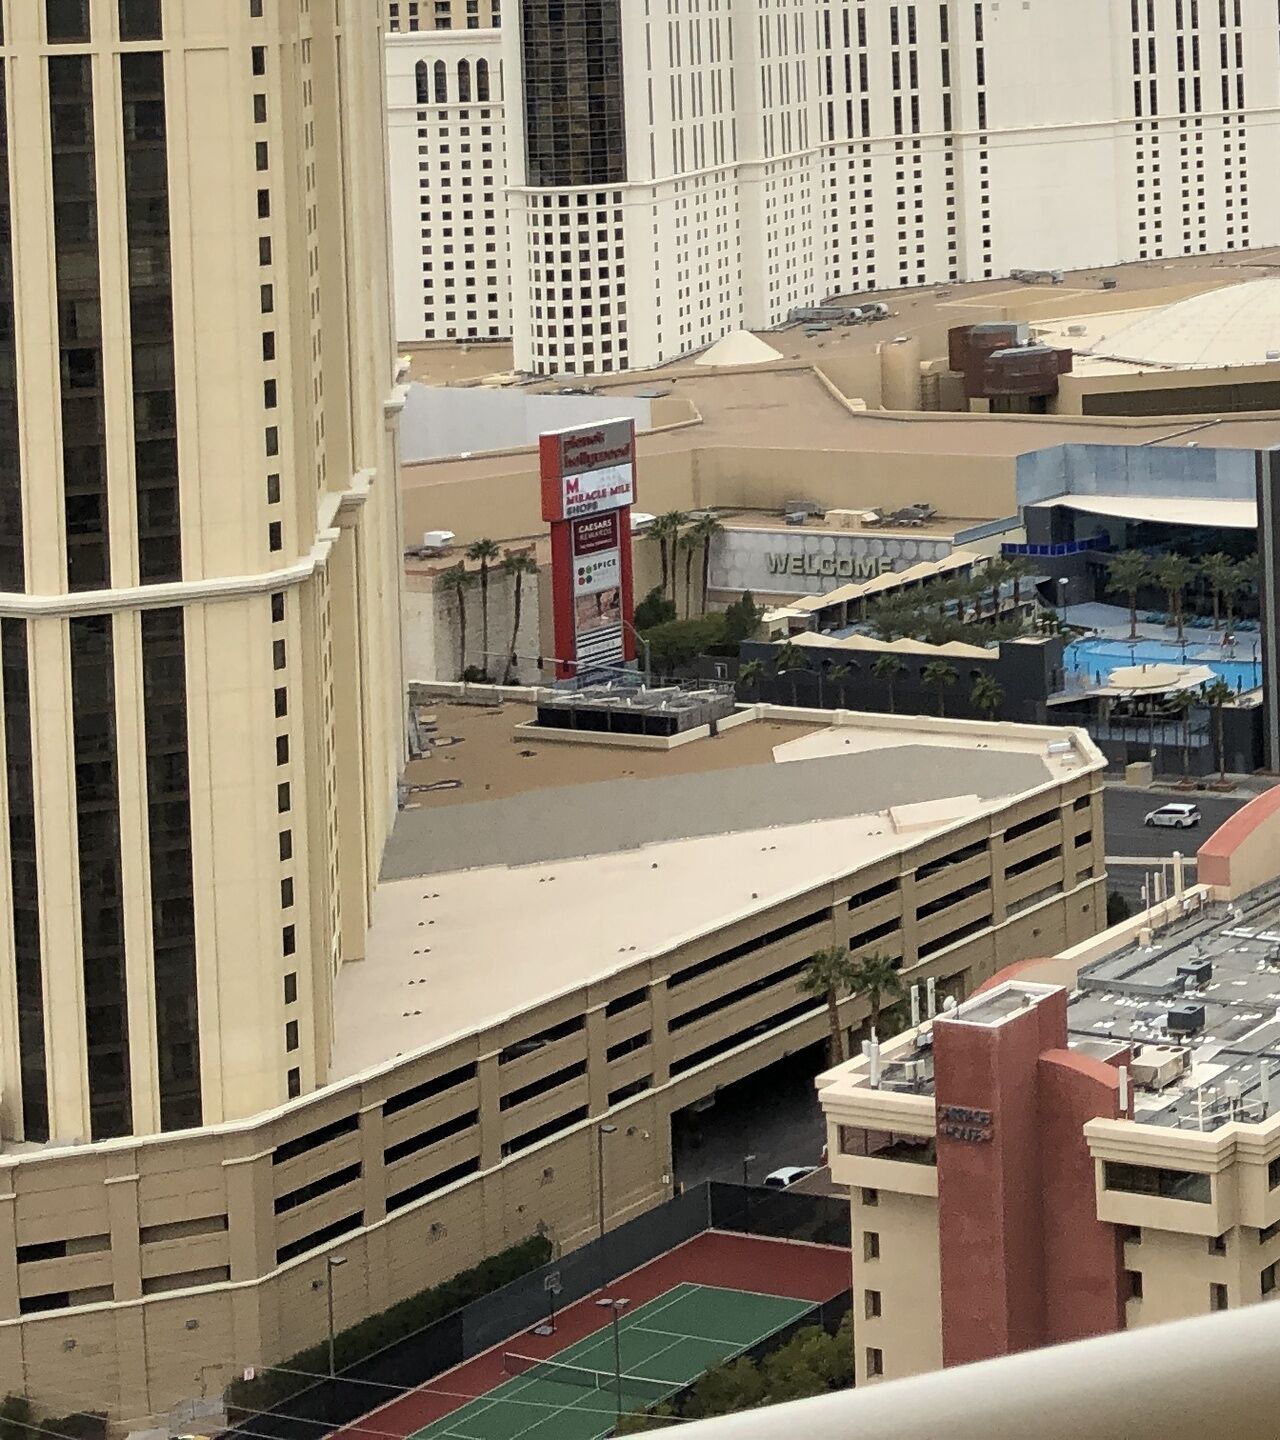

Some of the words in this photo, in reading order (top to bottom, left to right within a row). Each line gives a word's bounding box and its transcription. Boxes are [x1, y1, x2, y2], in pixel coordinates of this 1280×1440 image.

[566, 477, 580, 495] M
[566, 487, 607, 505] MIRACLE
[610, 483, 631, 496] MILE
[566, 501, 599, 515] SHOPS
[578, 518, 613, 533] CAESARS
[592, 558, 617, 571] SPICE
[766, 552, 894, 578] WELCOME
